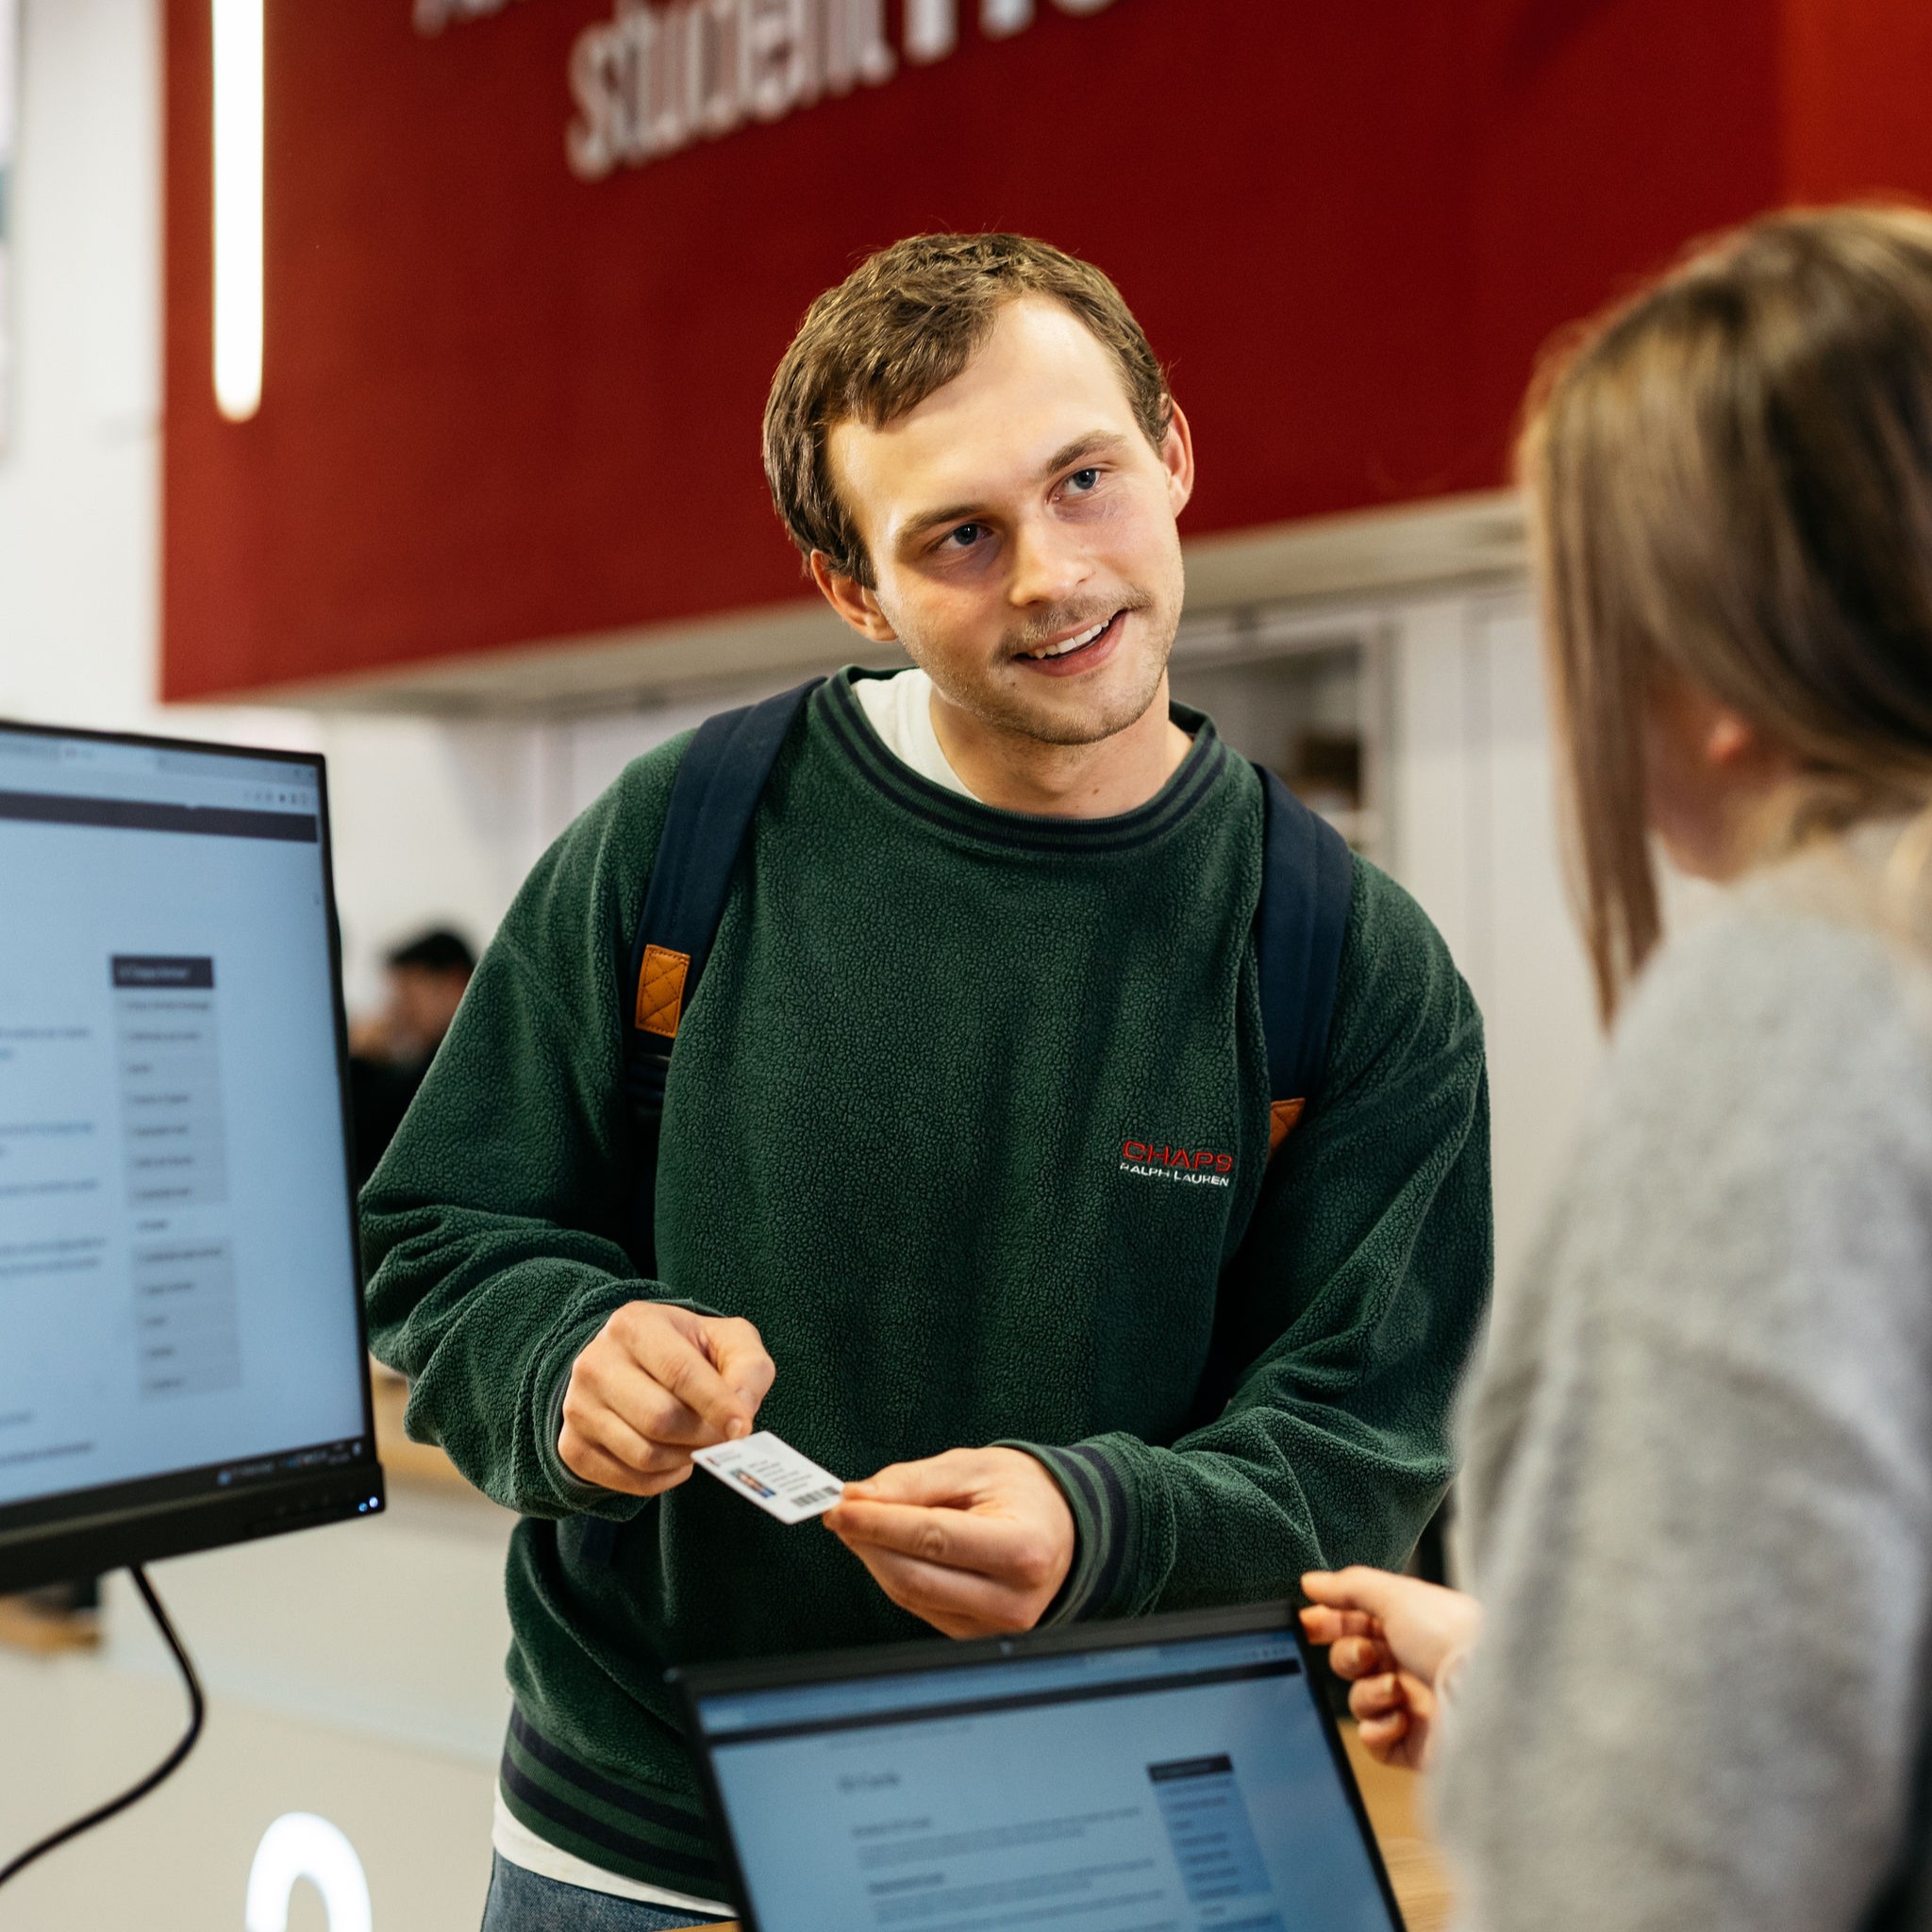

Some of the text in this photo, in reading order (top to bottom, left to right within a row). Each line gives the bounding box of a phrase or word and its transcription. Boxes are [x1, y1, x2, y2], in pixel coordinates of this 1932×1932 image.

[1123, 1141, 1233, 1172] CHAPS
[1120, 1162, 1229, 1187] RALPH LAUREN
